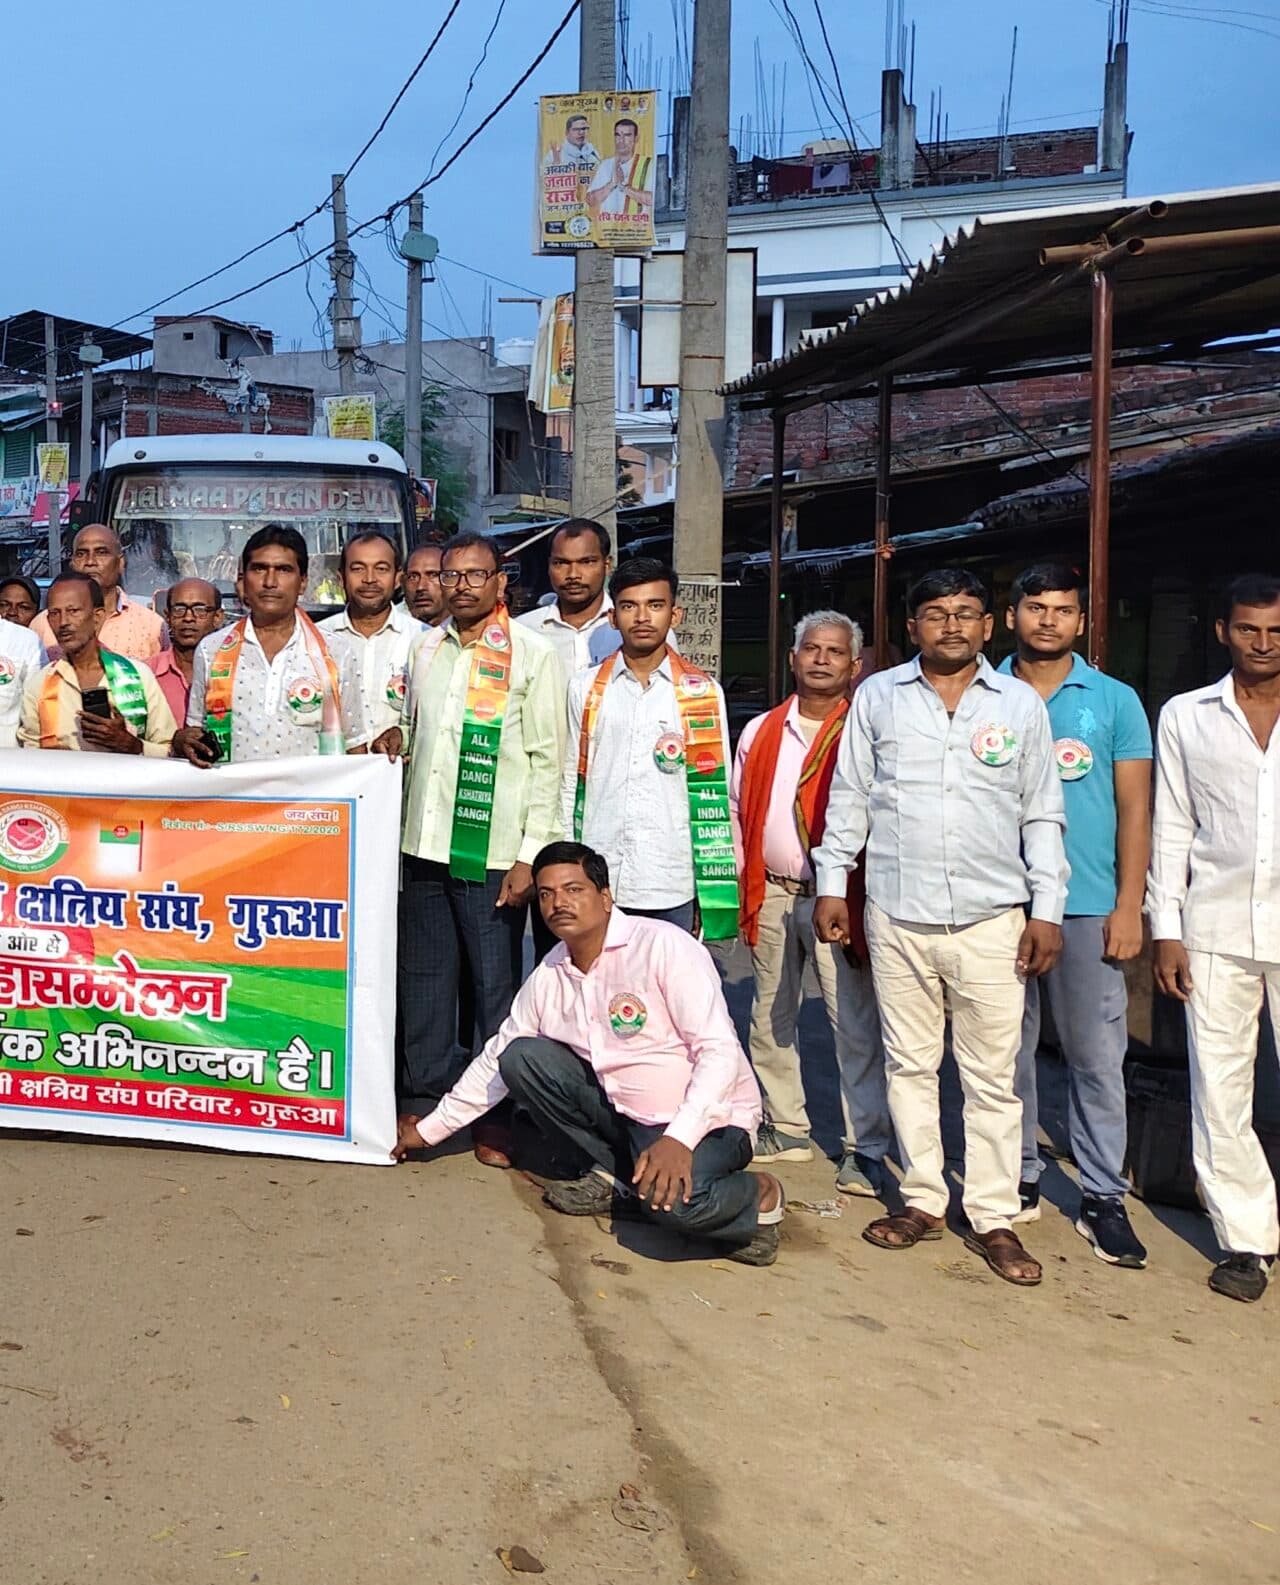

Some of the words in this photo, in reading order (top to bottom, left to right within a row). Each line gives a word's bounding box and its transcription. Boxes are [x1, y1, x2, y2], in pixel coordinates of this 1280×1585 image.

[327, 488, 389, 512] DEVI
[471, 733, 490, 748] ALL
[465, 751, 493, 766] INDIA
[461, 769, 493, 785] DANGI
[700, 788, 720, 800] ALL
[286, 810, 306, 820] जय
[457, 806, 489, 822] SANGH
[697, 807, 726, 820] INDIA
[698, 825, 730, 839] DANGI
[702, 864, 736, 877] SANGH
[138, 884, 211, 939] संघ,
[8, 932, 37, 951] ओर
[46, 935, 61, 953] से
[54, 1022, 267, 1085] अभिनन्दन
[20, 1076, 89, 1102] क्षत्रिय
[96, 1081, 138, 1107] संघ
[146, 1087, 242, 1117] परिवार,
